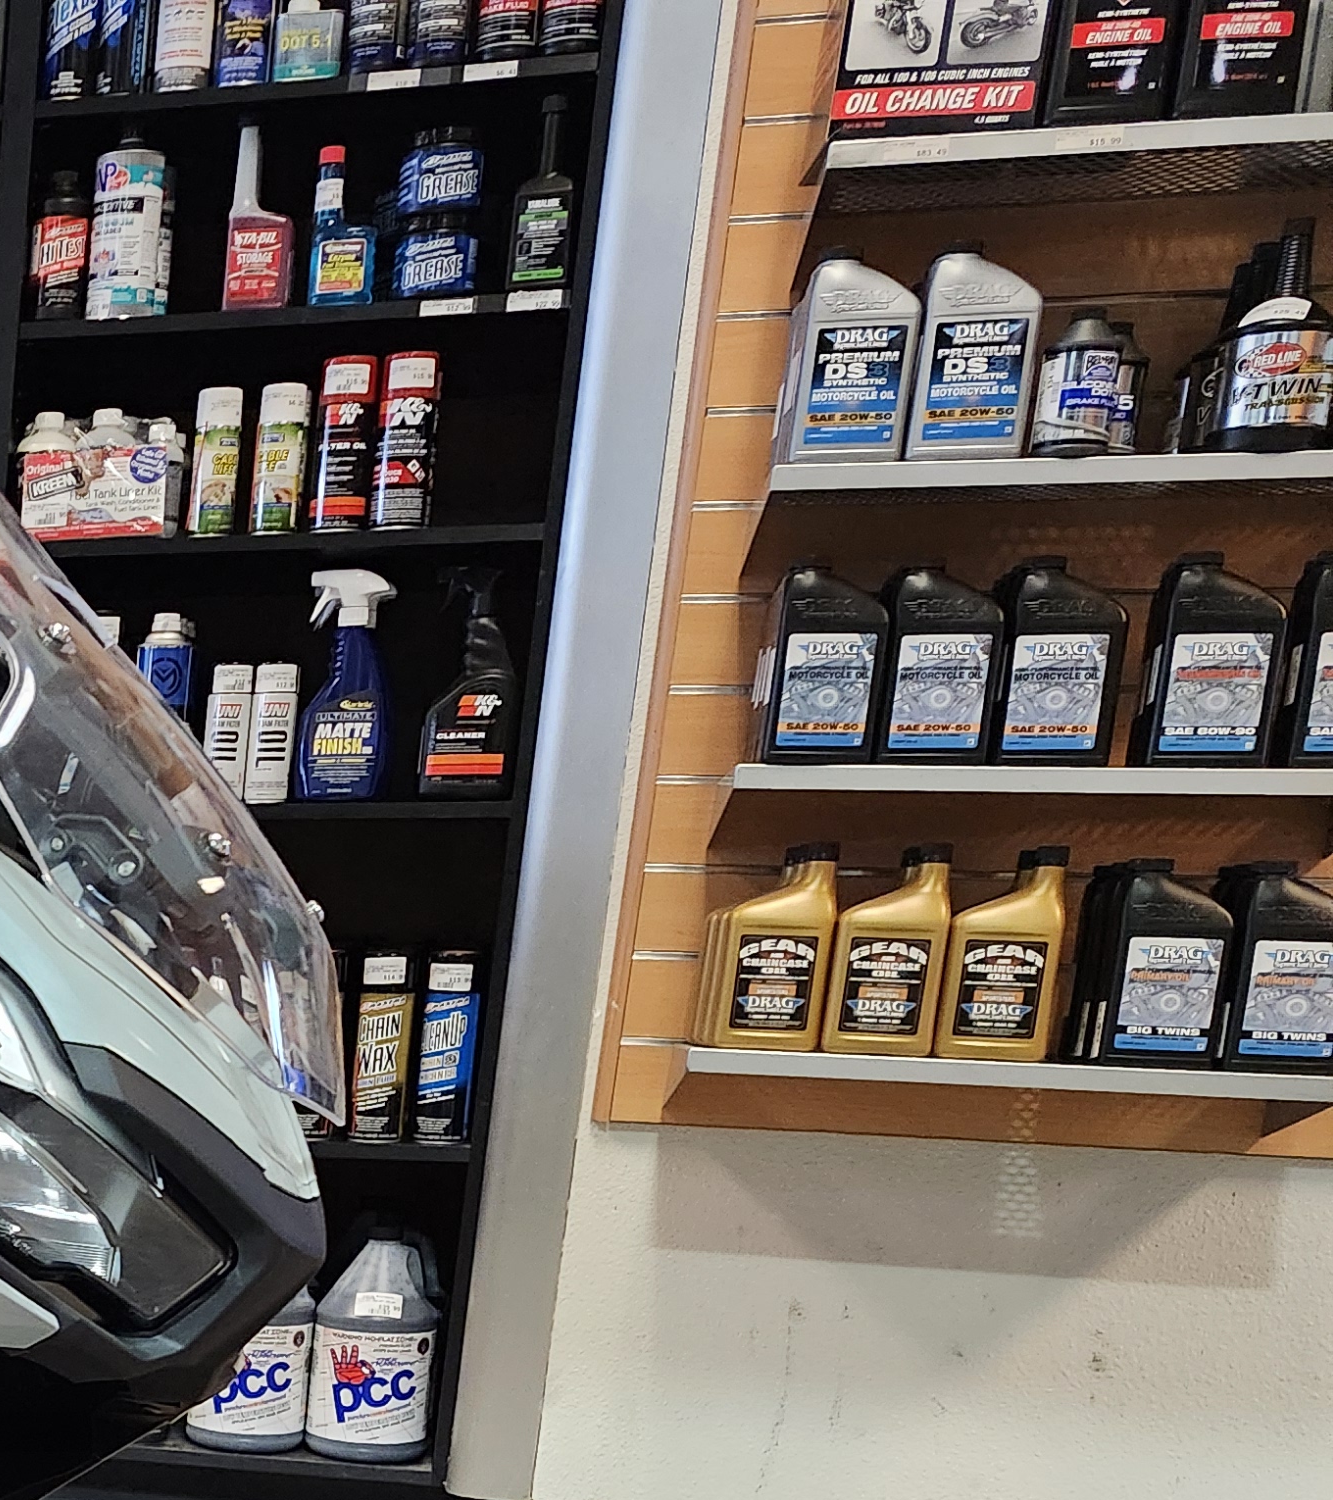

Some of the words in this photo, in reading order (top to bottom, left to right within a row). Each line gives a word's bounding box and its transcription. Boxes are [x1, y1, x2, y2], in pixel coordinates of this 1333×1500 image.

[1085, 30, 1133, 45] ENGINE
[1133, 28, 1154, 42] OIL
[1214, 22, 1264, 37] ENGINE
[1264, 21, 1283, 35] OIL
[279, 33, 310, 51] DOT
[854, 73, 874, 86] FOR
[874, 72, 891, 85] ALL
[937, 68, 966, 81] CUBIC
[966, 67, 990, 80] INCH
[990, 66, 1031, 79] ENGINES
[843, 91, 880, 116] OIL
[884, 86, 978, 114] CHANGE
[981, 84, 1025, 109] KIT
[98, 162, 119, 193] VP
[418, 169, 480, 204] GREASE
[234, 230, 277, 248] STA-BIL
[236, 251, 274, 265] STORAGE
[401, 253, 465, 290] GREASE
[835, 327, 890, 344] DRAG
[954, 320, 1011, 339] DRAG
[818, 350, 902, 365] PREMIUM
[936, 344, 1023, 361] PREMIUM
[1253, 352, 1276, 368] RED
[1276, 349, 1303, 366] LINE
[823, 376, 888, 388] SYNTHETIC
[942, 371, 1010, 383] SYNTHETIC
[811, 389, 879, 403] MOTORCYCLE
[879, 388, 897, 401] OIL
[930, 385, 999, 399] MOTORCYCLE
[1000, 384, 1019, 395] OIL
[387, 396, 434, 427] K&N
[809, 413, 837, 423] SAE
[839, 411, 894, 423] 20W-50
[927, 408, 957, 419] SAE
[958, 406, 1016, 418] 20W-50
[26, 463, 64, 476] Original
[32, 471, 78, 498] KREEM
[93, 487, 118, 499] Tank
[808, 641, 861, 656] DRAG
[918, 641, 973, 656] DRAG
[1034, 642, 1090, 657] DRAG
[1193, 641, 1250, 657] DRAG
[788, 669, 853, 681] MOTORCYCLE
[899, 670, 965, 682] MOTORCYCLE
[966, 671, 983, 680] OIL
[1013, 671, 1082, 683] MOTORCYCLE
[1082, 671, 1101, 682] OIL
[216, 703, 242, 718] UNI
[261, 702, 289, 718] UNI
[474, 694, 503, 717] K&N
[315, 711, 377, 722] ULTIMATE
[314, 722, 372, 739] MATTE
[786, 722, 810, 732] SAE
[811, 722, 860, 732] 20W-50
[895, 723, 921, 733] SAE
[922, 723, 972, 733] 20W-50
[1009, 724, 1036, 734] SAE
[1036, 724, 1089, 734] 20W-50
[1163, 726, 1195, 737] SAE
[1196, 726, 1257, 737] 80W-90
[436, 731, 486, 740] CLEANER
[312, 737, 363, 756] FINISH
[739, 938, 816, 963] GEAR
[849, 940, 928, 966] GEAR
[963, 943, 1045, 969] GEAR
[1149, 944, 1204, 961] DRAG
[1275, 948, 1332, 965] DRAG
[741, 957, 810, 969] CHAINCASE
[851, 960, 922, 972] CHAINCASE
[966, 963, 1038, 976] CHAINCASE
[760, 966, 790, 976] OIL
[870, 969, 902, 979] OIL
[985, 971, 1018, 982] OIL
[1130, 970, 1175, 983] PRIMARY
[747, 996, 795, 1012] DRAG
[857, 999, 906, 1015] DRAG
[972, 1001, 1023, 1018] DRAG
[358, 1010, 403, 1044] CHAIN
[1126, 1026, 1152, 1036] BIG
[1155, 1026, 1201, 1037] TWINS
[1251, 1030, 1279, 1040] BIG
[1280, 1031, 1327, 1042] TWINS
[357, 1041, 400, 1079] WAX
[331, 1368, 418, 1424] pcc
